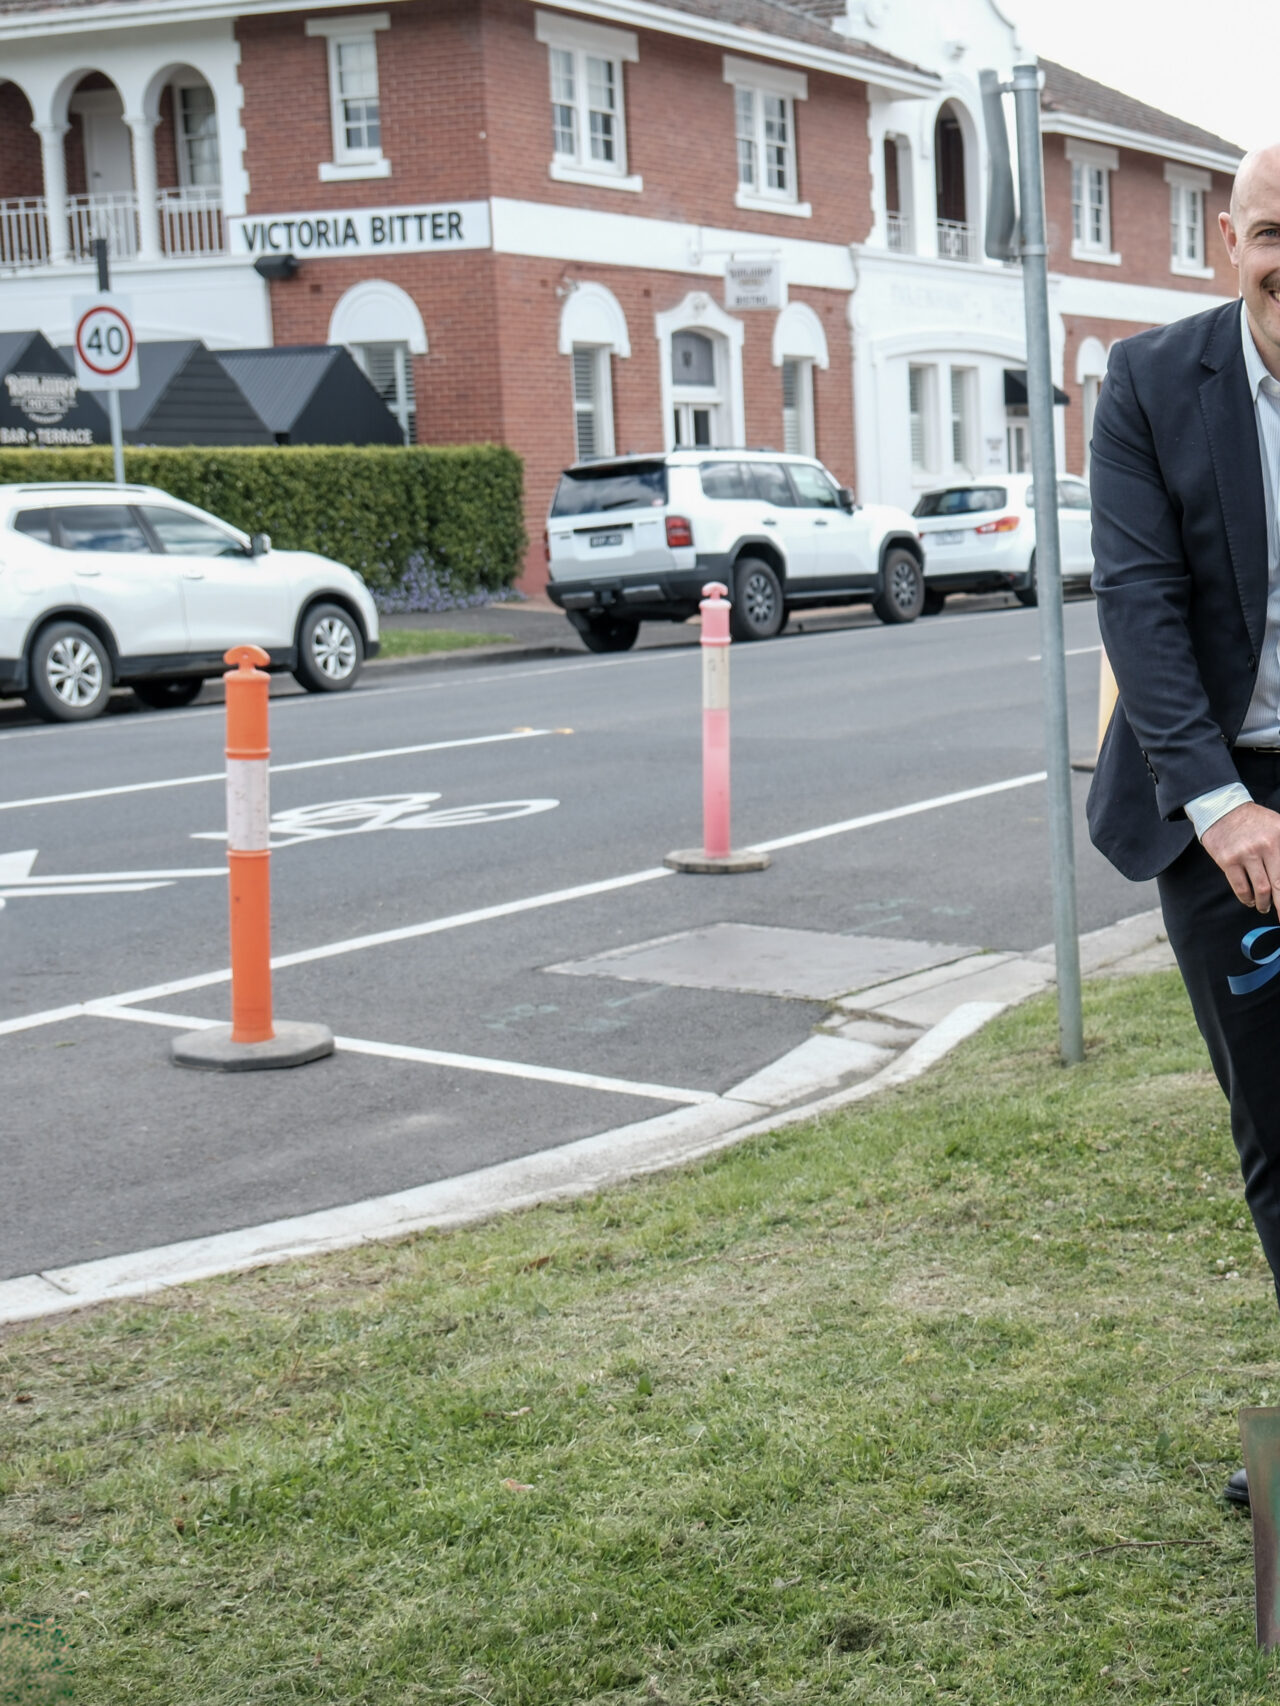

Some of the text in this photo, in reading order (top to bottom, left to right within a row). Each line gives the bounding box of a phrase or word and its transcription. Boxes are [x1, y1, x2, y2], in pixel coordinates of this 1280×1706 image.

[242, 211, 464, 251] VICTORIA BITTER
[86, 326, 124, 356] 40
[0, 427, 94, 445] BAR TERRACE
